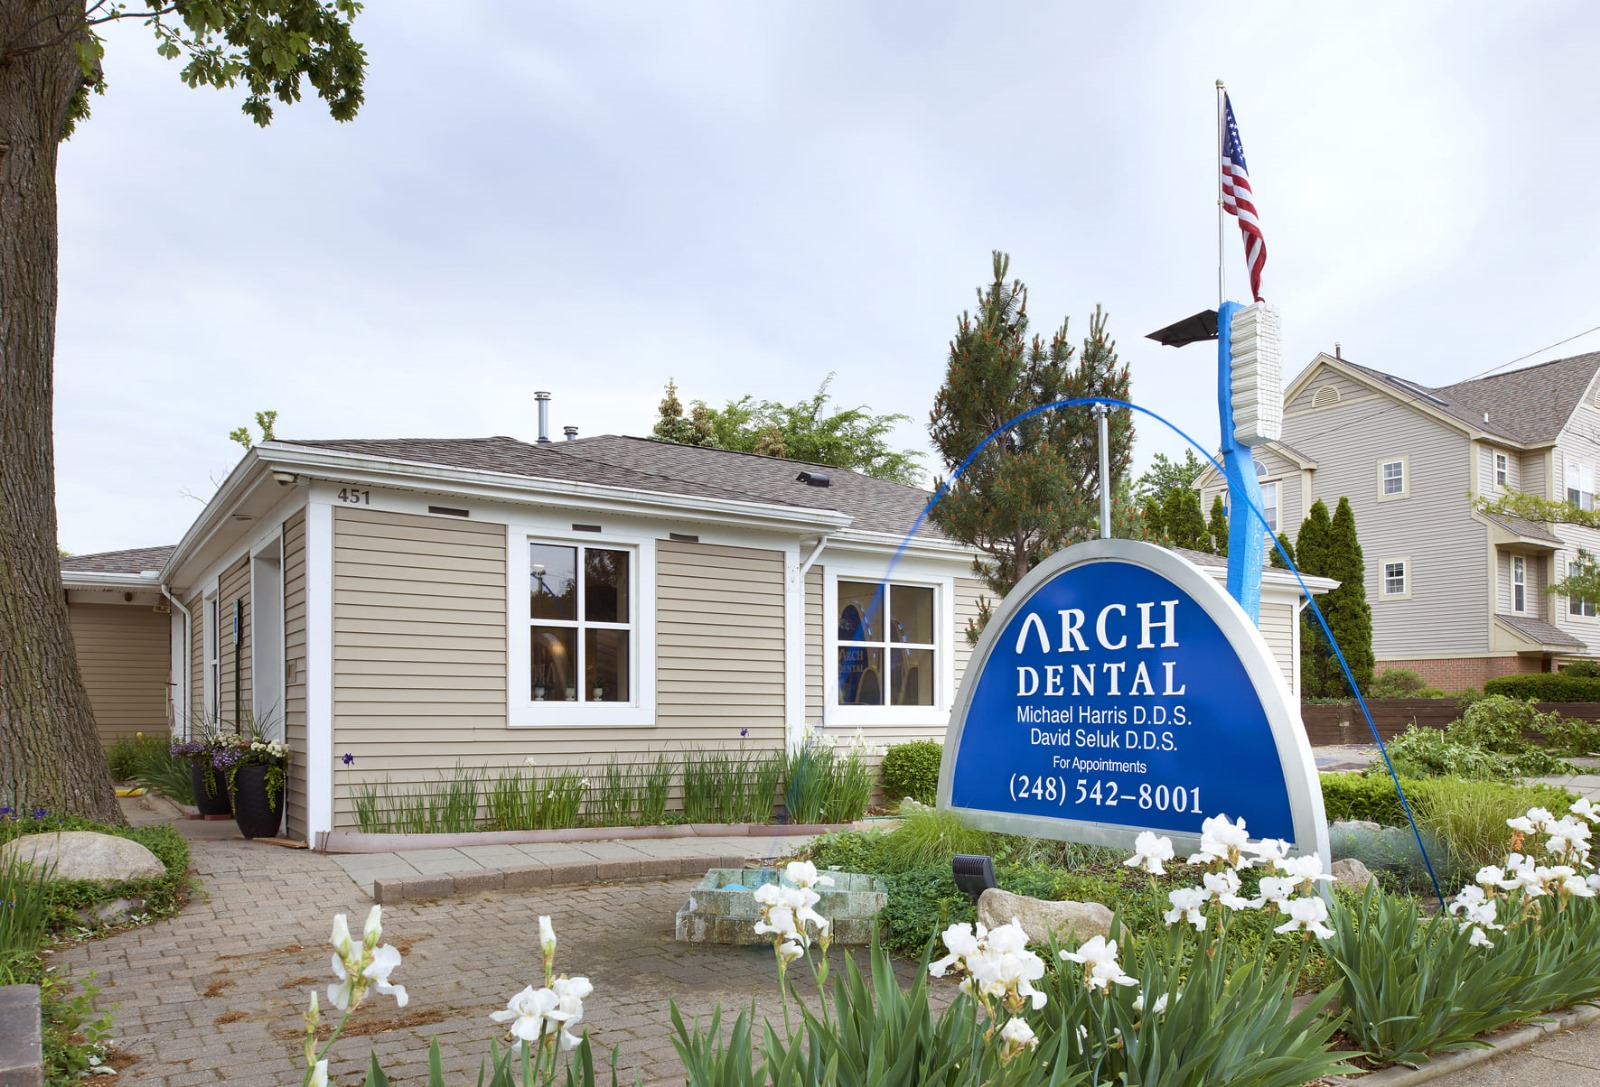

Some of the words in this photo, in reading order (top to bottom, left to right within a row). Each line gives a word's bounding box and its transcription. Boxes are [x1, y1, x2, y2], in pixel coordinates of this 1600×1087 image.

[337, 488, 370, 505] 451
[1015, 599, 1179, 654] ARCH
[1016, 661, 1186, 697] DENTAL
[1017, 705, 1073, 723] Michael
[1078, 706, 1127, 725] Harris
[1133, 705, 1192, 725] D.D.S.
[1030, 728, 1070, 747] David
[1075, 729, 1120, 748] Seluk
[1126, 731, 1178, 751] D.D.S.
[1053, 756, 1070, 769] For
[1072, 757, 1147, 773] Appointments
[1009, 773, 1066, 806] (248)
[1075, 779, 1203, 814] 542-8001
